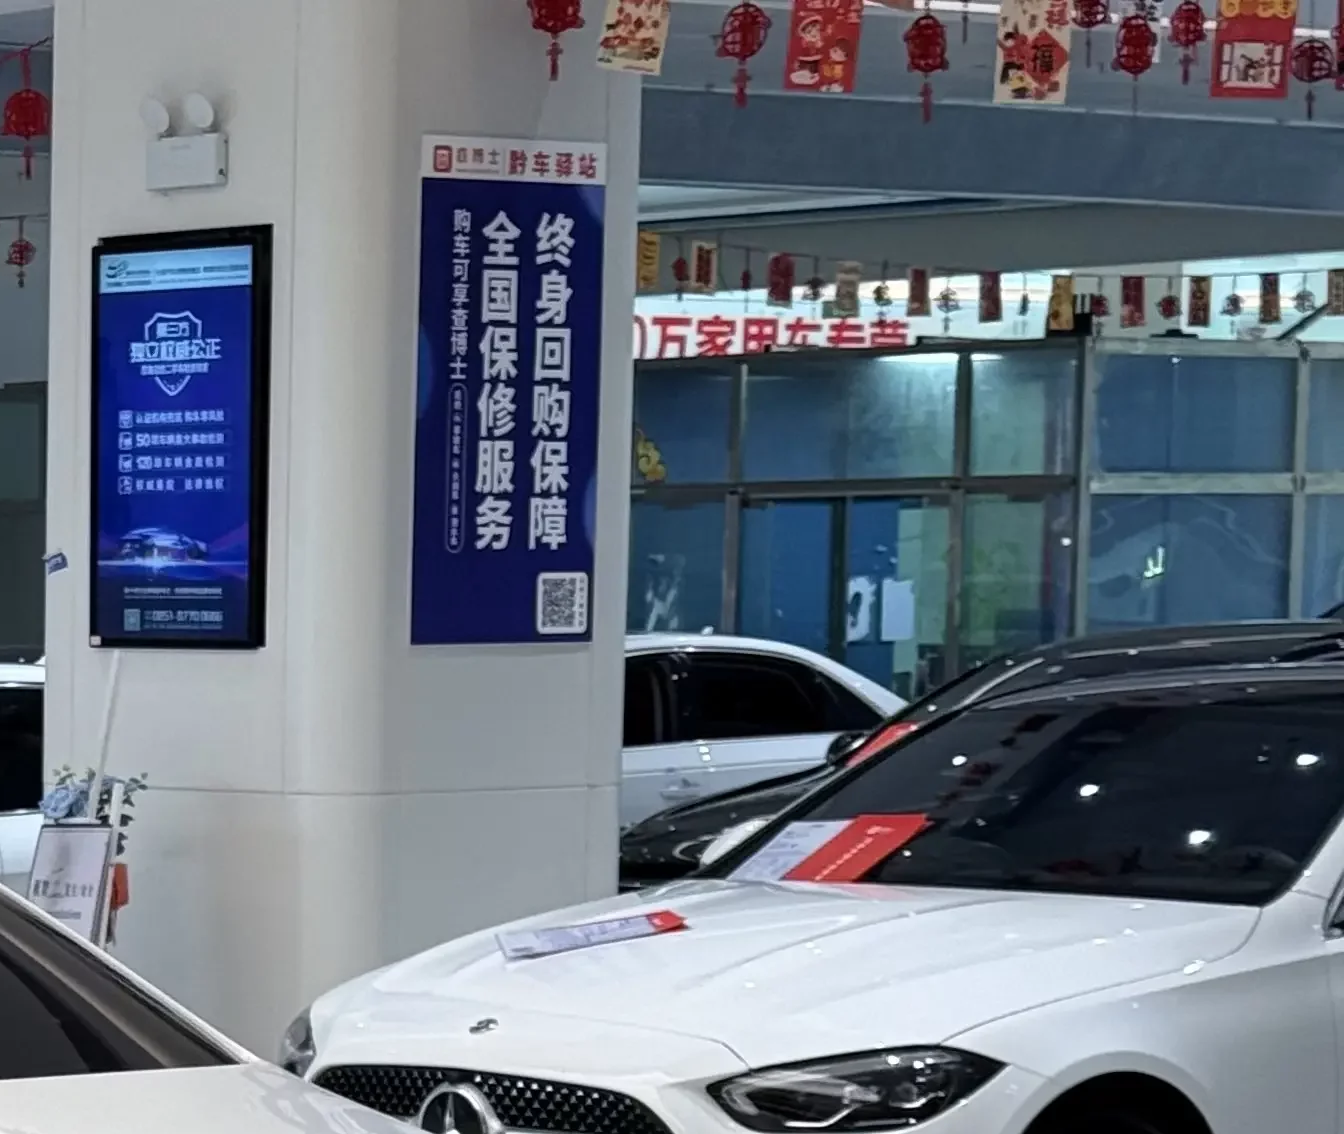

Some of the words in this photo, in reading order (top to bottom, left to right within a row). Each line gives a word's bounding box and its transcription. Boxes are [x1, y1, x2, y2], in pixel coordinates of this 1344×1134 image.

[508, 149, 598, 179] 黔车驿站
[475, 210, 521, 550] 全国保修服务
[528, 212, 575, 550] 终身回购保障
